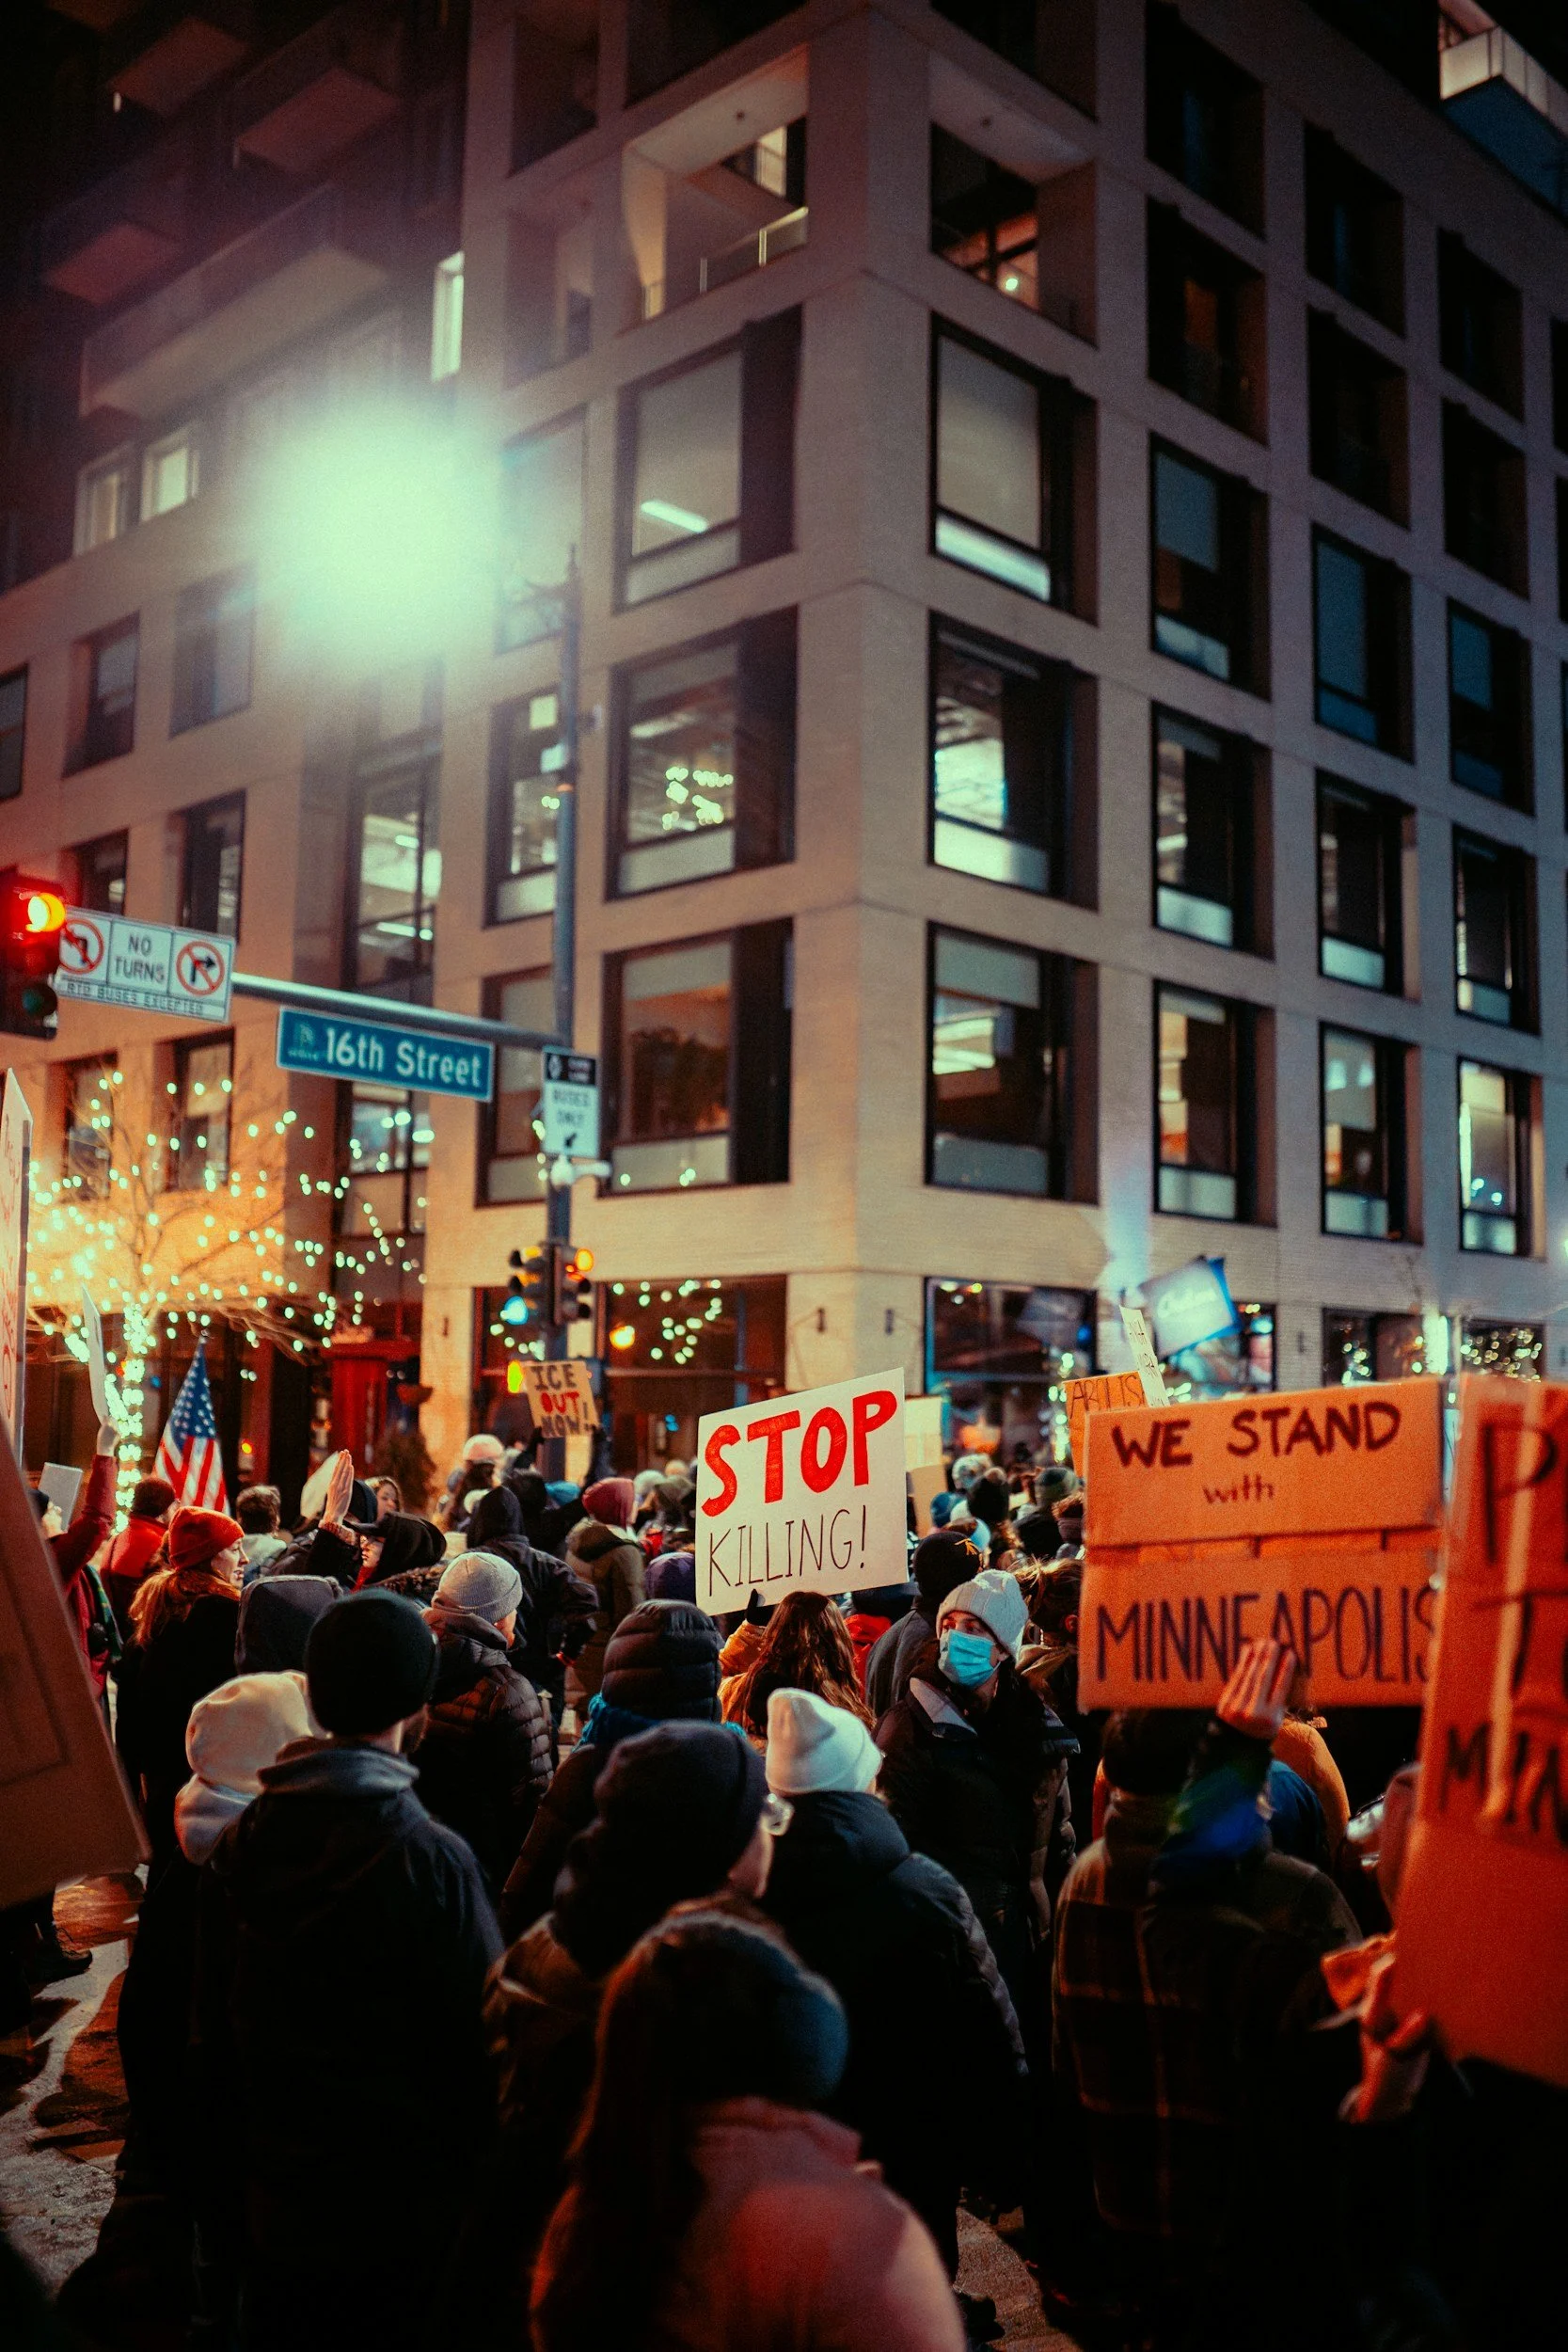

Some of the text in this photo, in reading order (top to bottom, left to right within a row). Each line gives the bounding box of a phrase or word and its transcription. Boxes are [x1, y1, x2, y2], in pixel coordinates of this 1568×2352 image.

[129, 934, 152, 957] NO
[114, 957, 166, 982] TURNS
[97, 987, 136, 1005] BUSES
[326, 1026, 483, 1088] 16th Street
[530, 1364, 577, 1391] ICE
[541, 1391, 579, 1414] OUT
[1069, 1374, 1146, 1419] ABOLIS
[1111, 1400, 1402, 1469] WE STAND
[702, 1390, 897, 1518] STOP
[1203, 1473, 1275, 1505] with
[709, 1504, 865, 1597] KILLING!
